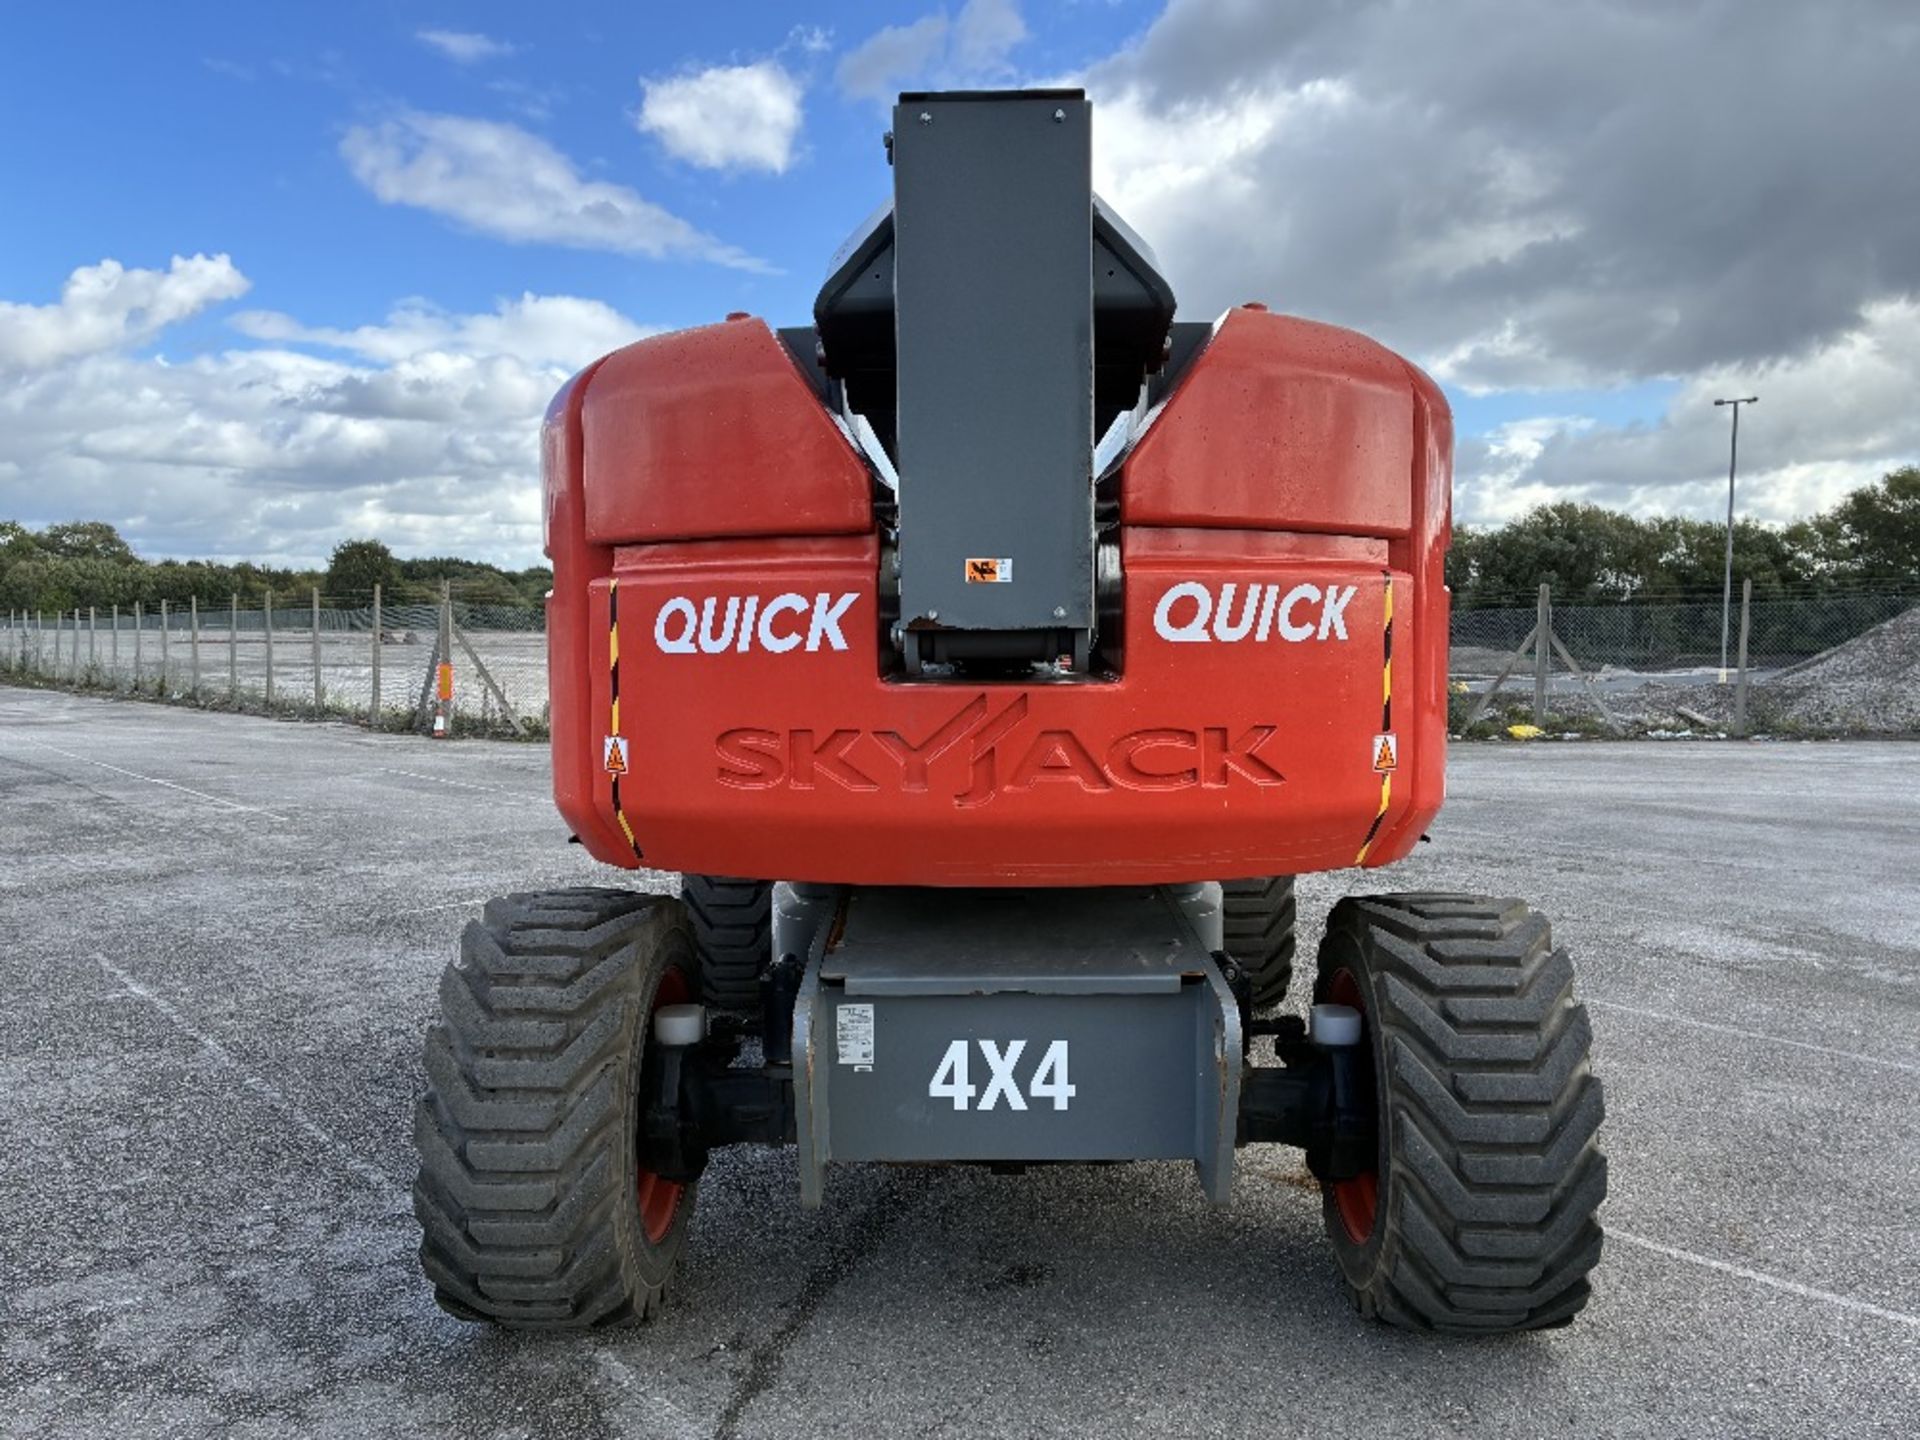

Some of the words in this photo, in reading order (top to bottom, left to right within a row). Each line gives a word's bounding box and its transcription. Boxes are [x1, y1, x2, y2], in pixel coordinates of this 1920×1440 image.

[653, 592, 861, 655] QUICK
[1152, 580, 1360, 643] QUICK
[714, 691, 1288, 810] SKYJACK
[928, 1039, 1077, 1112] 4X4
